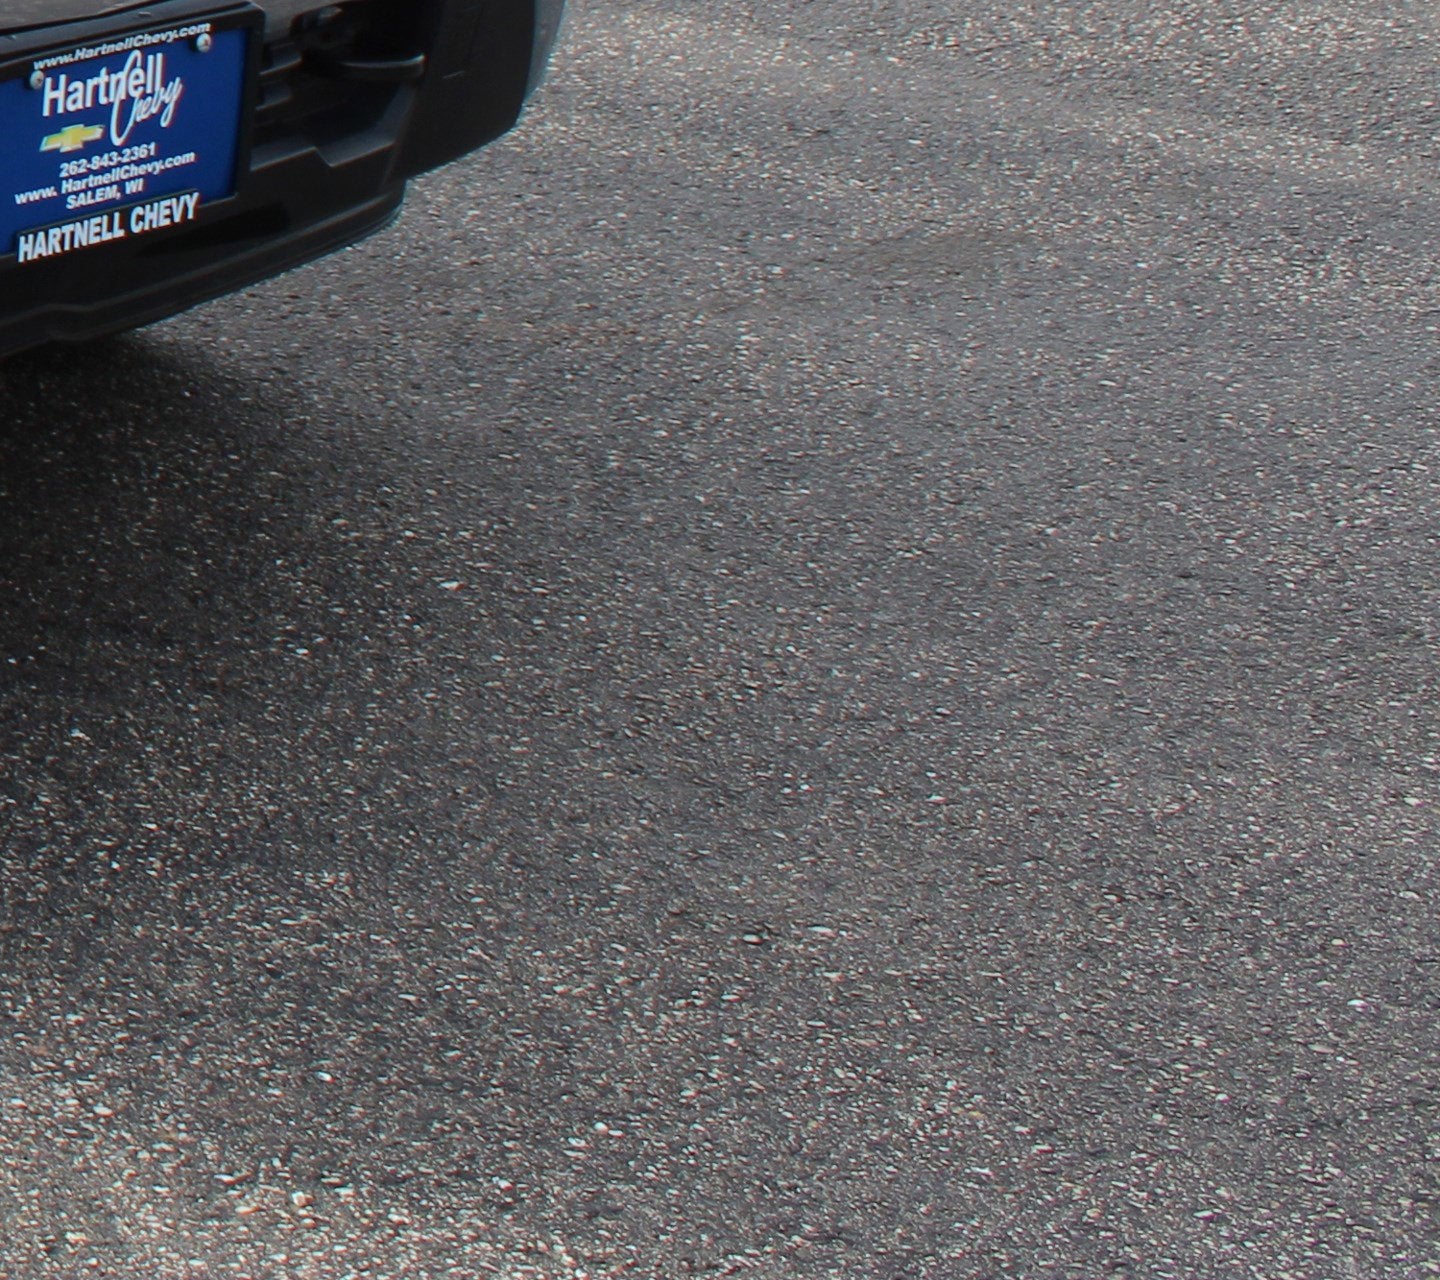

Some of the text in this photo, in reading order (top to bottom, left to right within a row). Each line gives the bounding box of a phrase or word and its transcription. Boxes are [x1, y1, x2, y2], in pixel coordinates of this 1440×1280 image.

[33, 22, 210, 70] www.HartnellChevy.com
[42, 52, 162, 117] Hartnell
[110, 50, 182, 145] Chevy
[59, 142, 156, 178] 262-843-2361
[66, 178, 143, 209] SALEM, WI
[18, 192, 200, 263] HARTNELL CHEVY
